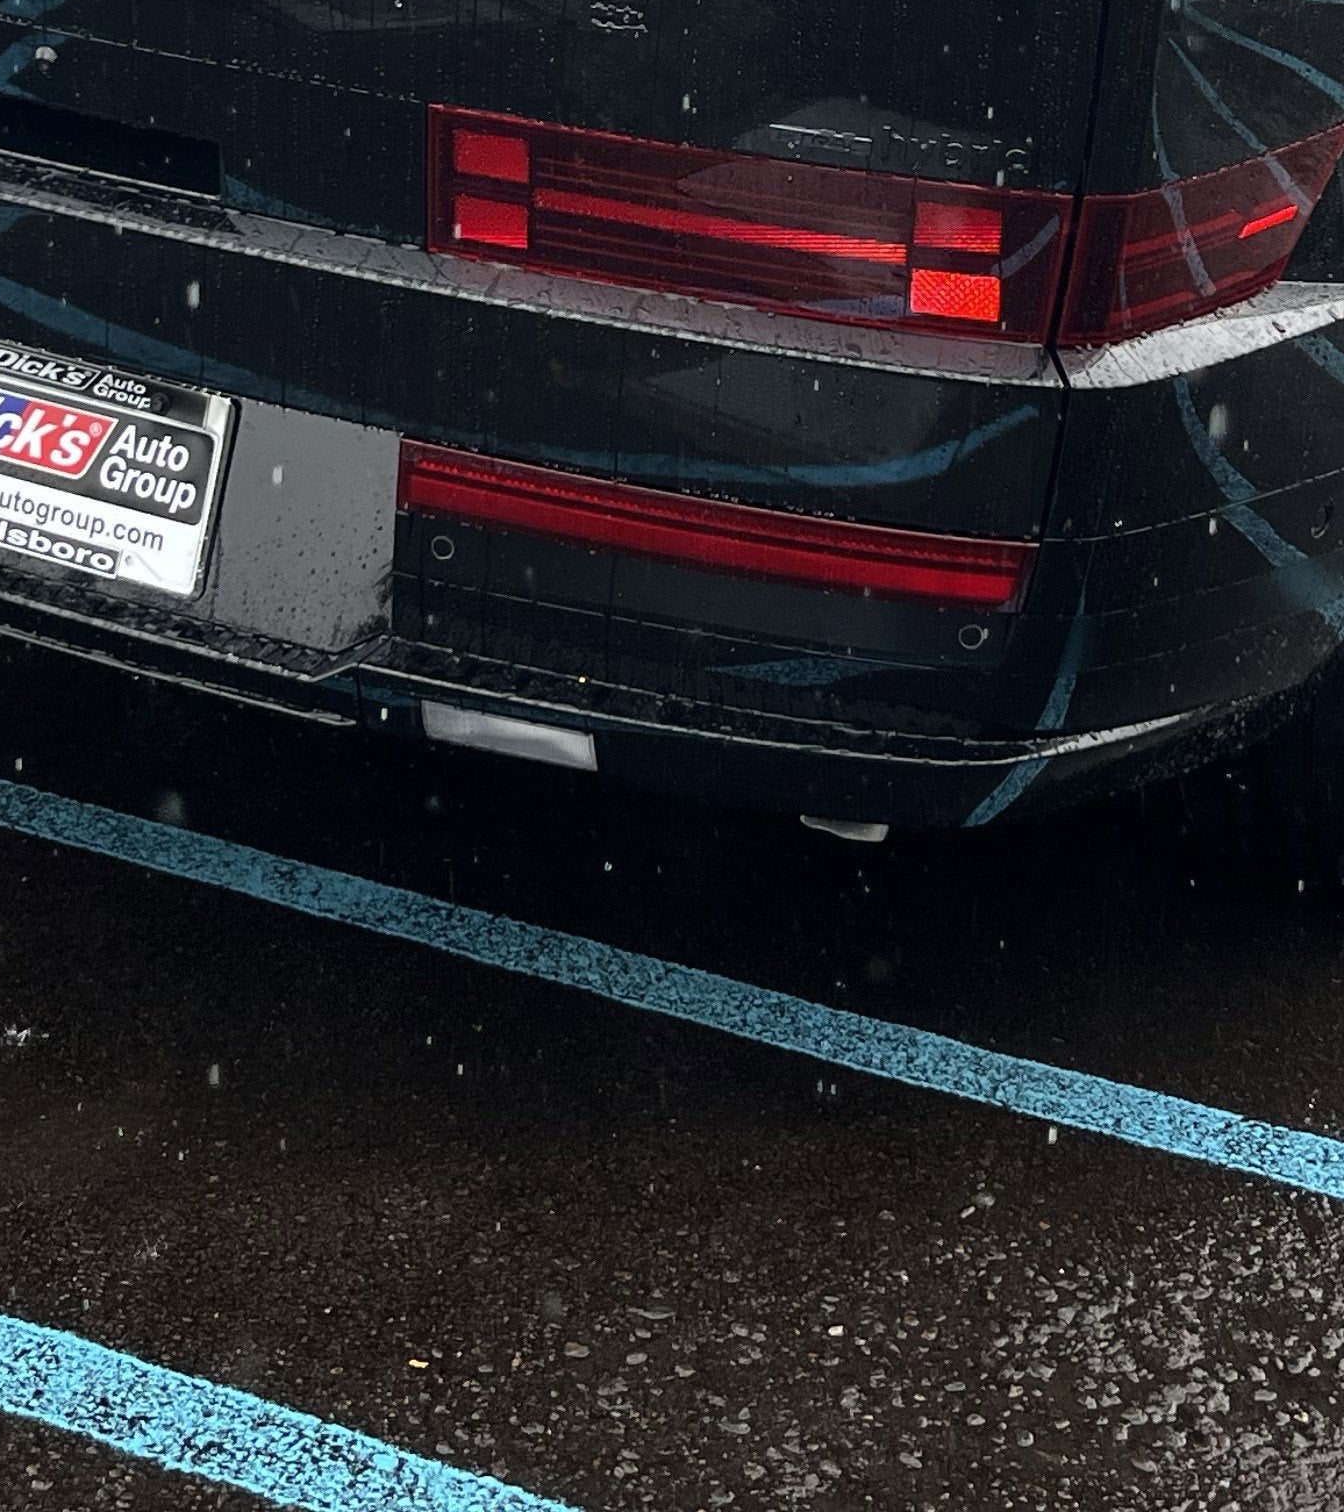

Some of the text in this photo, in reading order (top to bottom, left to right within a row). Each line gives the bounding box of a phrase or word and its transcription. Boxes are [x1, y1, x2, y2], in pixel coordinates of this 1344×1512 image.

[93, 383, 152, 409] Group
[101, 373, 147, 395] Auto
[109, 424, 190, 472] Auto
[99, 454, 197, 514] Group
